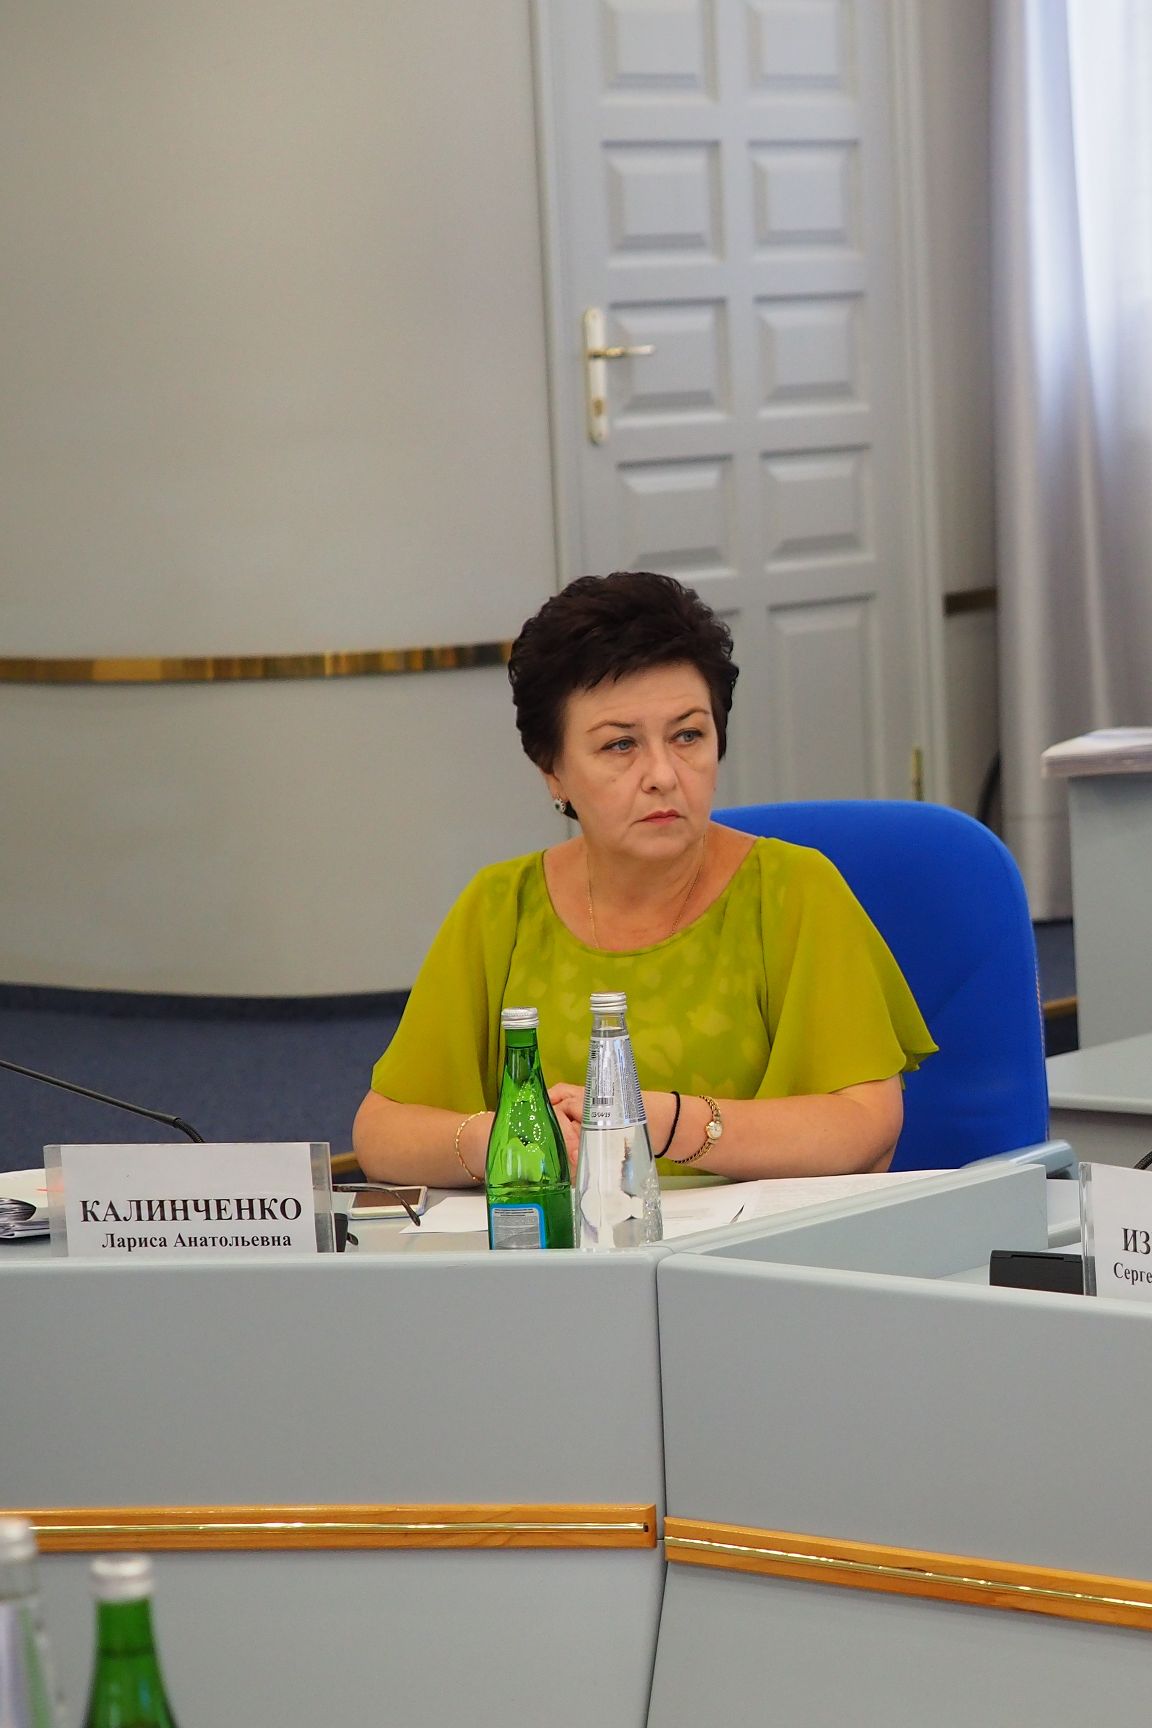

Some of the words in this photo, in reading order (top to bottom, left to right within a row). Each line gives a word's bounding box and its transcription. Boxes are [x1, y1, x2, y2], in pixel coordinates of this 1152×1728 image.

[80, 1198, 302, 1222] КАЛИНЧЕНКО
[102, 1233, 168, 1251] Лариса
[174, 1233, 291, 1248] Анатольевна
